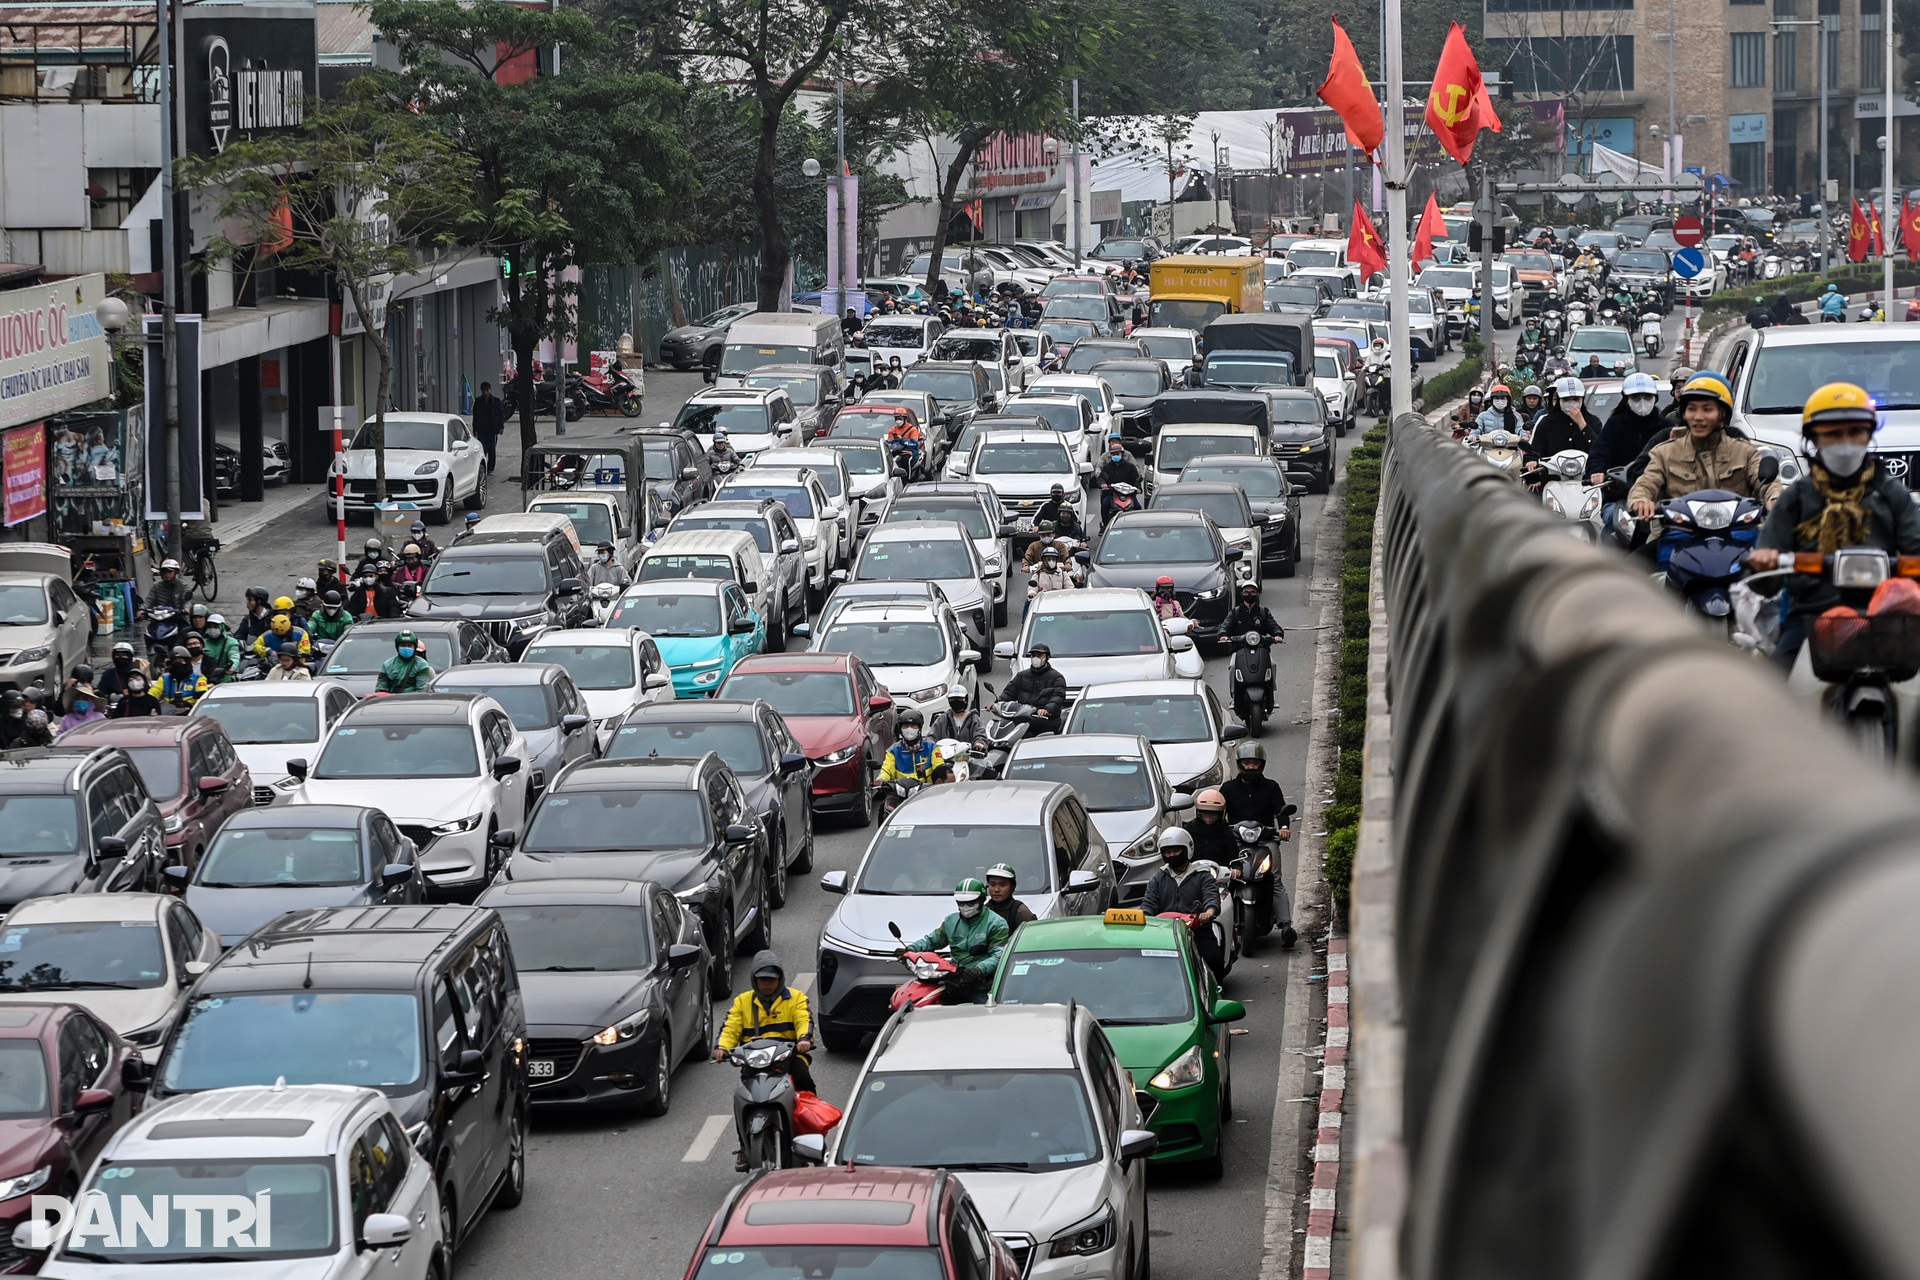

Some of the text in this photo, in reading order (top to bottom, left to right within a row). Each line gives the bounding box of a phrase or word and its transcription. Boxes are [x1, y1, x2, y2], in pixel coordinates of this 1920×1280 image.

[1190, 275, 1228, 288] CHÍNH
[48, 290, 67, 349] ỐC
[1110, 913, 1138, 922] TAXI
[528, 1062, 553, 1076] 6.33
